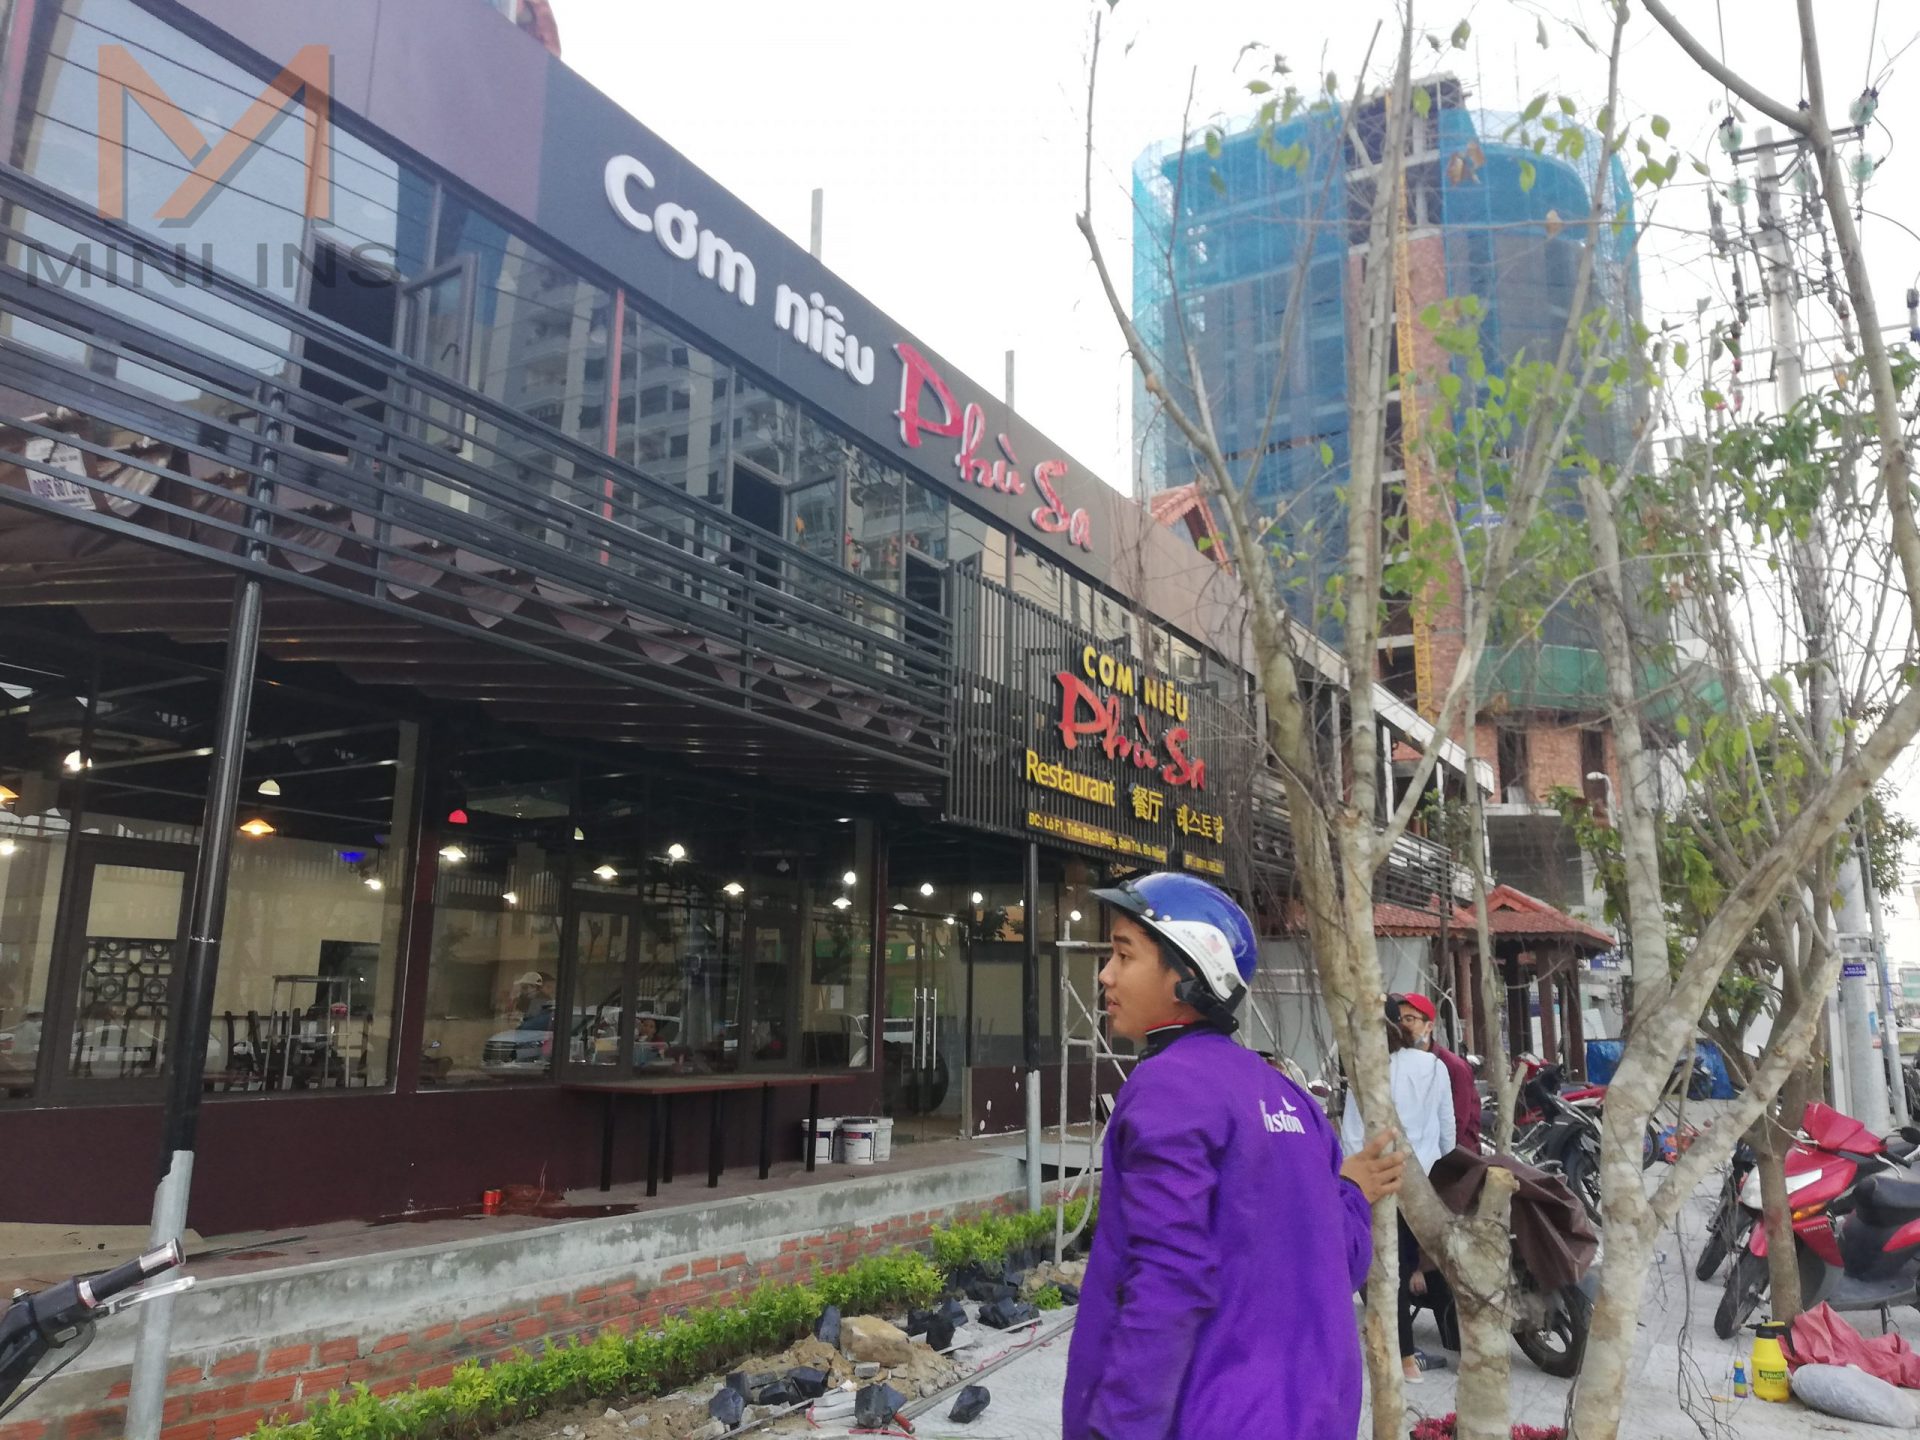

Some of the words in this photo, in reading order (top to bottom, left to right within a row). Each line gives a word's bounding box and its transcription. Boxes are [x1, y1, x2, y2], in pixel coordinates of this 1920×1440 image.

[604, 154, 756, 306] Cơm
[1026, 749, 1115, 807] Restaurant
[1132, 784, 1163, 824] 餐厅
[1176, 803, 1224, 844] 레스토랑
[1803, 1224, 1827, 1232] HONDA
